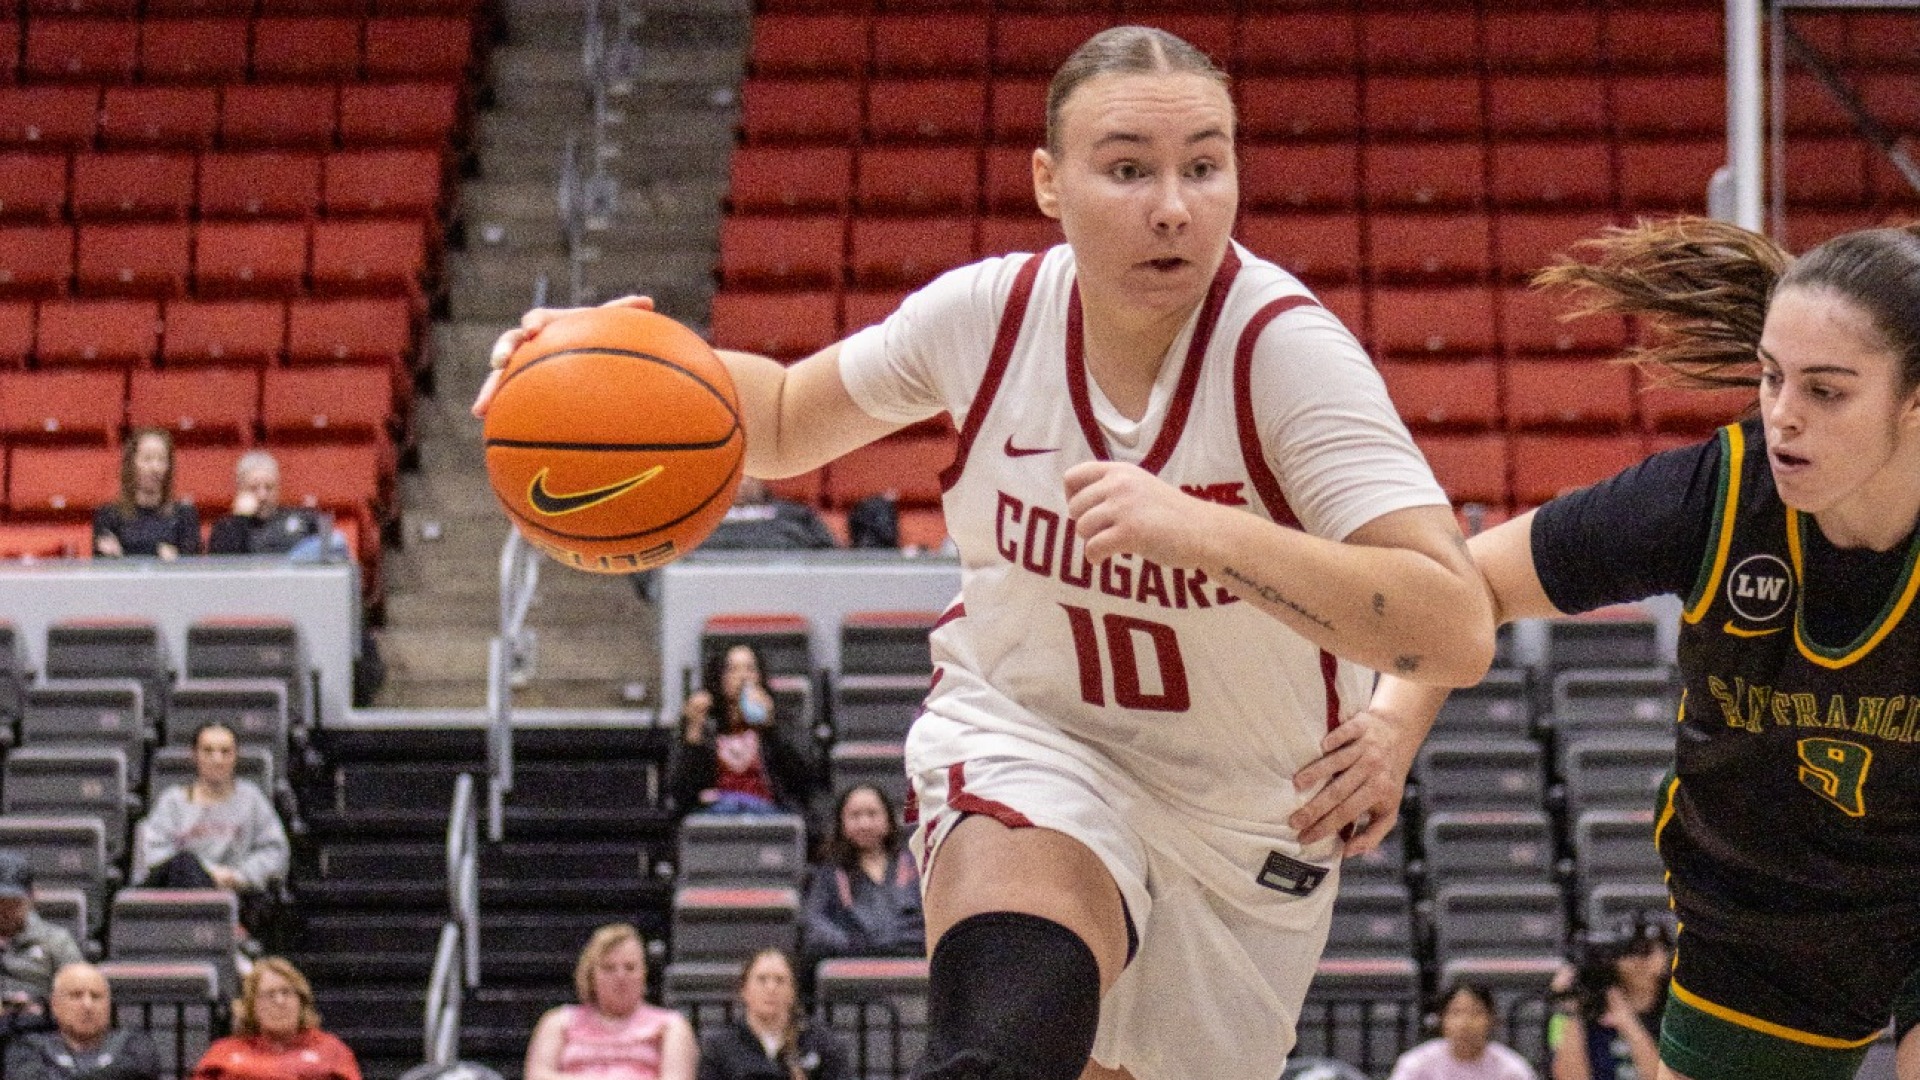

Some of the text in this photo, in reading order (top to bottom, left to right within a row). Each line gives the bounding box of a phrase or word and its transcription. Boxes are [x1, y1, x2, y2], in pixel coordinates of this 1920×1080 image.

[1735, 573, 1786, 602] LW
[1056, 602, 1191, 713] 10
[1770, 690, 1920, 743] FRANCI
[1797, 736, 1873, 818] 9
